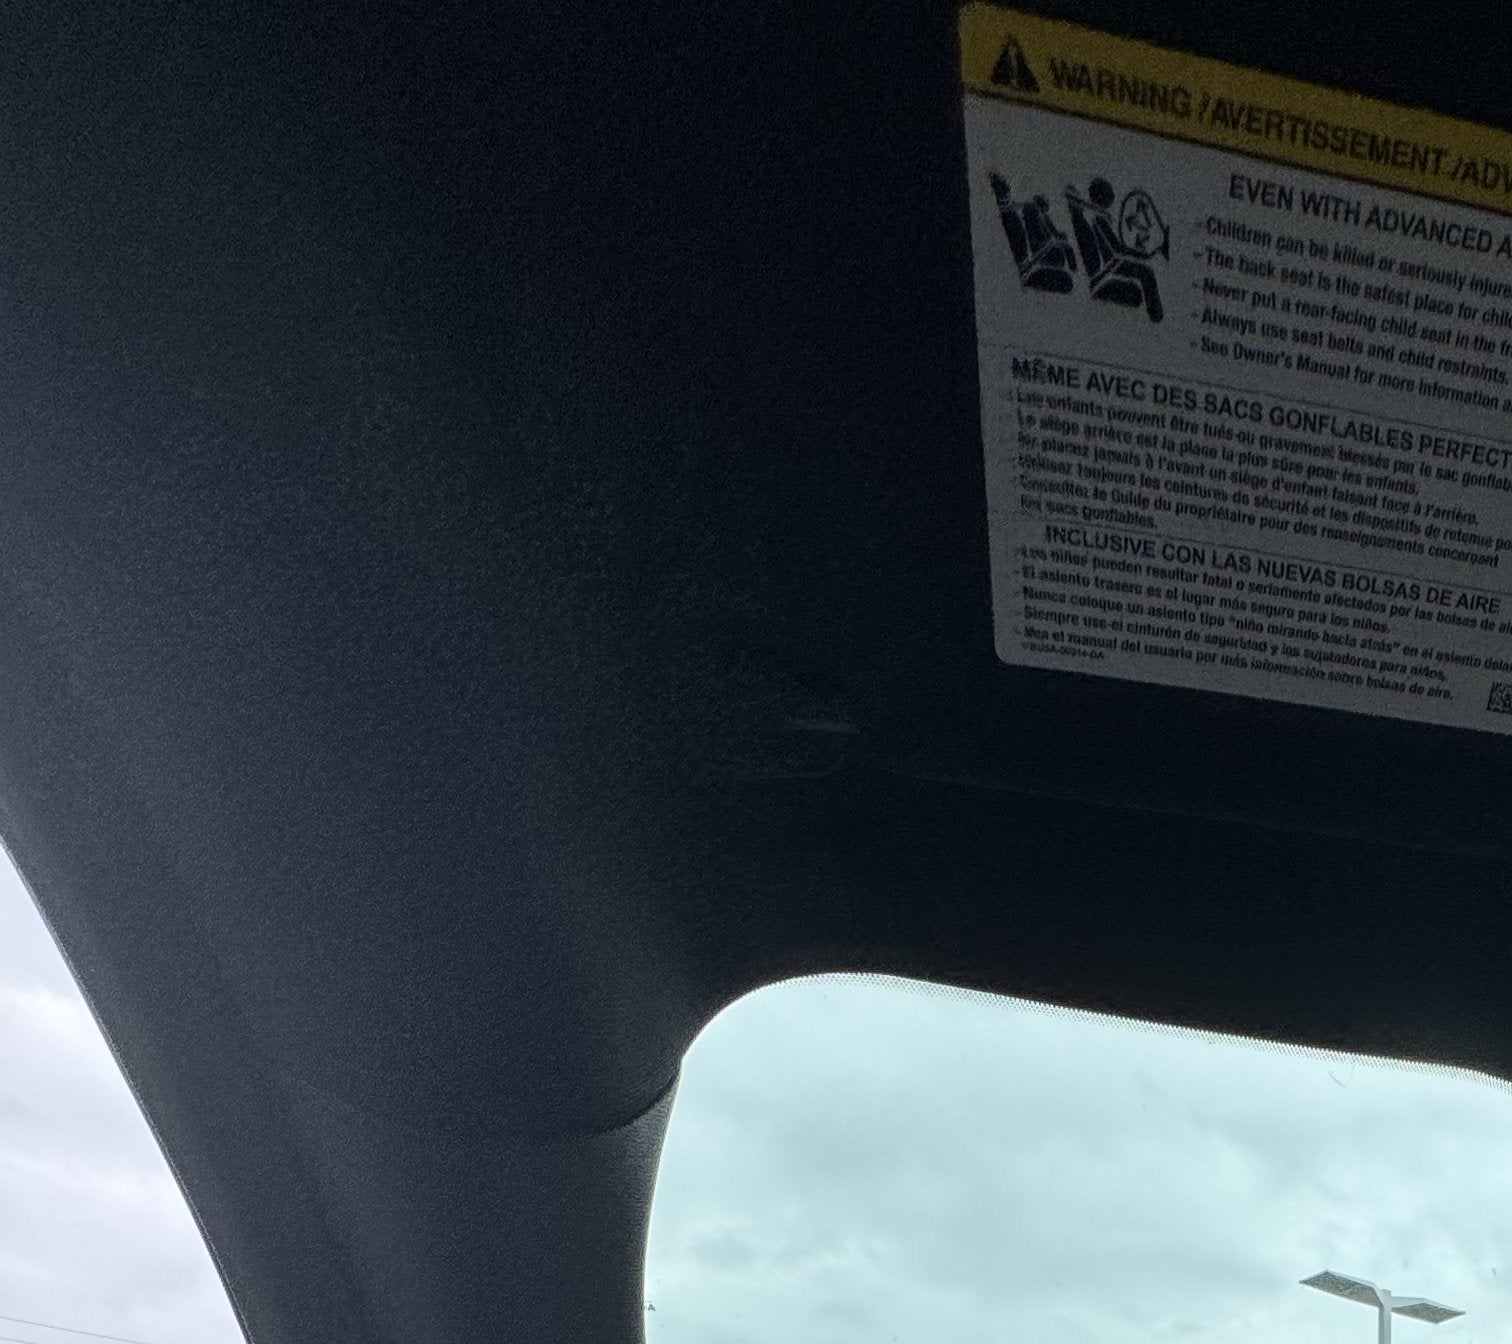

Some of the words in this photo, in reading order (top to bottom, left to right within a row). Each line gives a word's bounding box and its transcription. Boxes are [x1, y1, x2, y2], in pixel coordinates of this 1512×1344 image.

[1049, 56, 1191, 119] WARNING
[1229, 174, 1293, 212] EVEN
[1299, 189, 1361, 226] WITH
[1365, 204, 1494, 255] ADVANCED
[1205, 247, 1233, 271] The
[1238, 254, 1274, 279] back
[1280, 264, 1313, 287] seat
[1317, 271, 1331, 291] is
[1335, 274, 1361, 297] the
[1363, 281, 1410, 307] safest
[1413, 292, 1454, 318] place
[1457, 300, 1478, 321] for
[1206, 216, 1271, 248] Children
[1276, 235, 1304, 255] can
[1308, 238, 1329, 260] be
[1332, 243, 1374, 270] killed
[1377, 257, 1394, 274] or
[1396, 258, 1466, 292] seriously
[1201, 305, 1256, 337] Always
[1260, 321, 1287, 339] use
[1291, 325, 1323, 346] seat
[1367, 339, 1394, 361] and
[1398, 346, 1435, 369] child
[1203, 278, 1247, 303] Never
[1251, 288, 1276, 312] put
[1281, 298, 1291, 312] a
[1293, 295, 1377, 333] rear-facing
[1380, 315, 1417, 337] child
[1420, 323, 1452, 345] seat
[1455, 330, 1470, 348] in
[1472, 334, 1496, 354] the
[1201, 335, 1228, 356] See
[1233, 341, 1292, 369] Owner's
[1296, 354, 1350, 380] Manual
[1353, 365, 1375, 385] for
[1378, 374, 1414, 393] more
[1418, 379, 1499, 410] information
[1087, 370, 1146, 401] AVEC
[1153, 383, 1197, 411] DES
[1203, 393, 1263, 424] SACS
[1268, 405, 1414, 452] GONFLABLES
[1045, 522, 1156, 559] INCLUSIVE
[1162, 542, 1205, 567] CON
[1211, 550, 1251, 574] LAS
[1257, 557, 1336, 588] NUEVAS
[1341, 572, 1421, 601] BOLSAS
[1425, 586, 1453, 607] DE
[1455, 592, 1500, 614] AIRE
